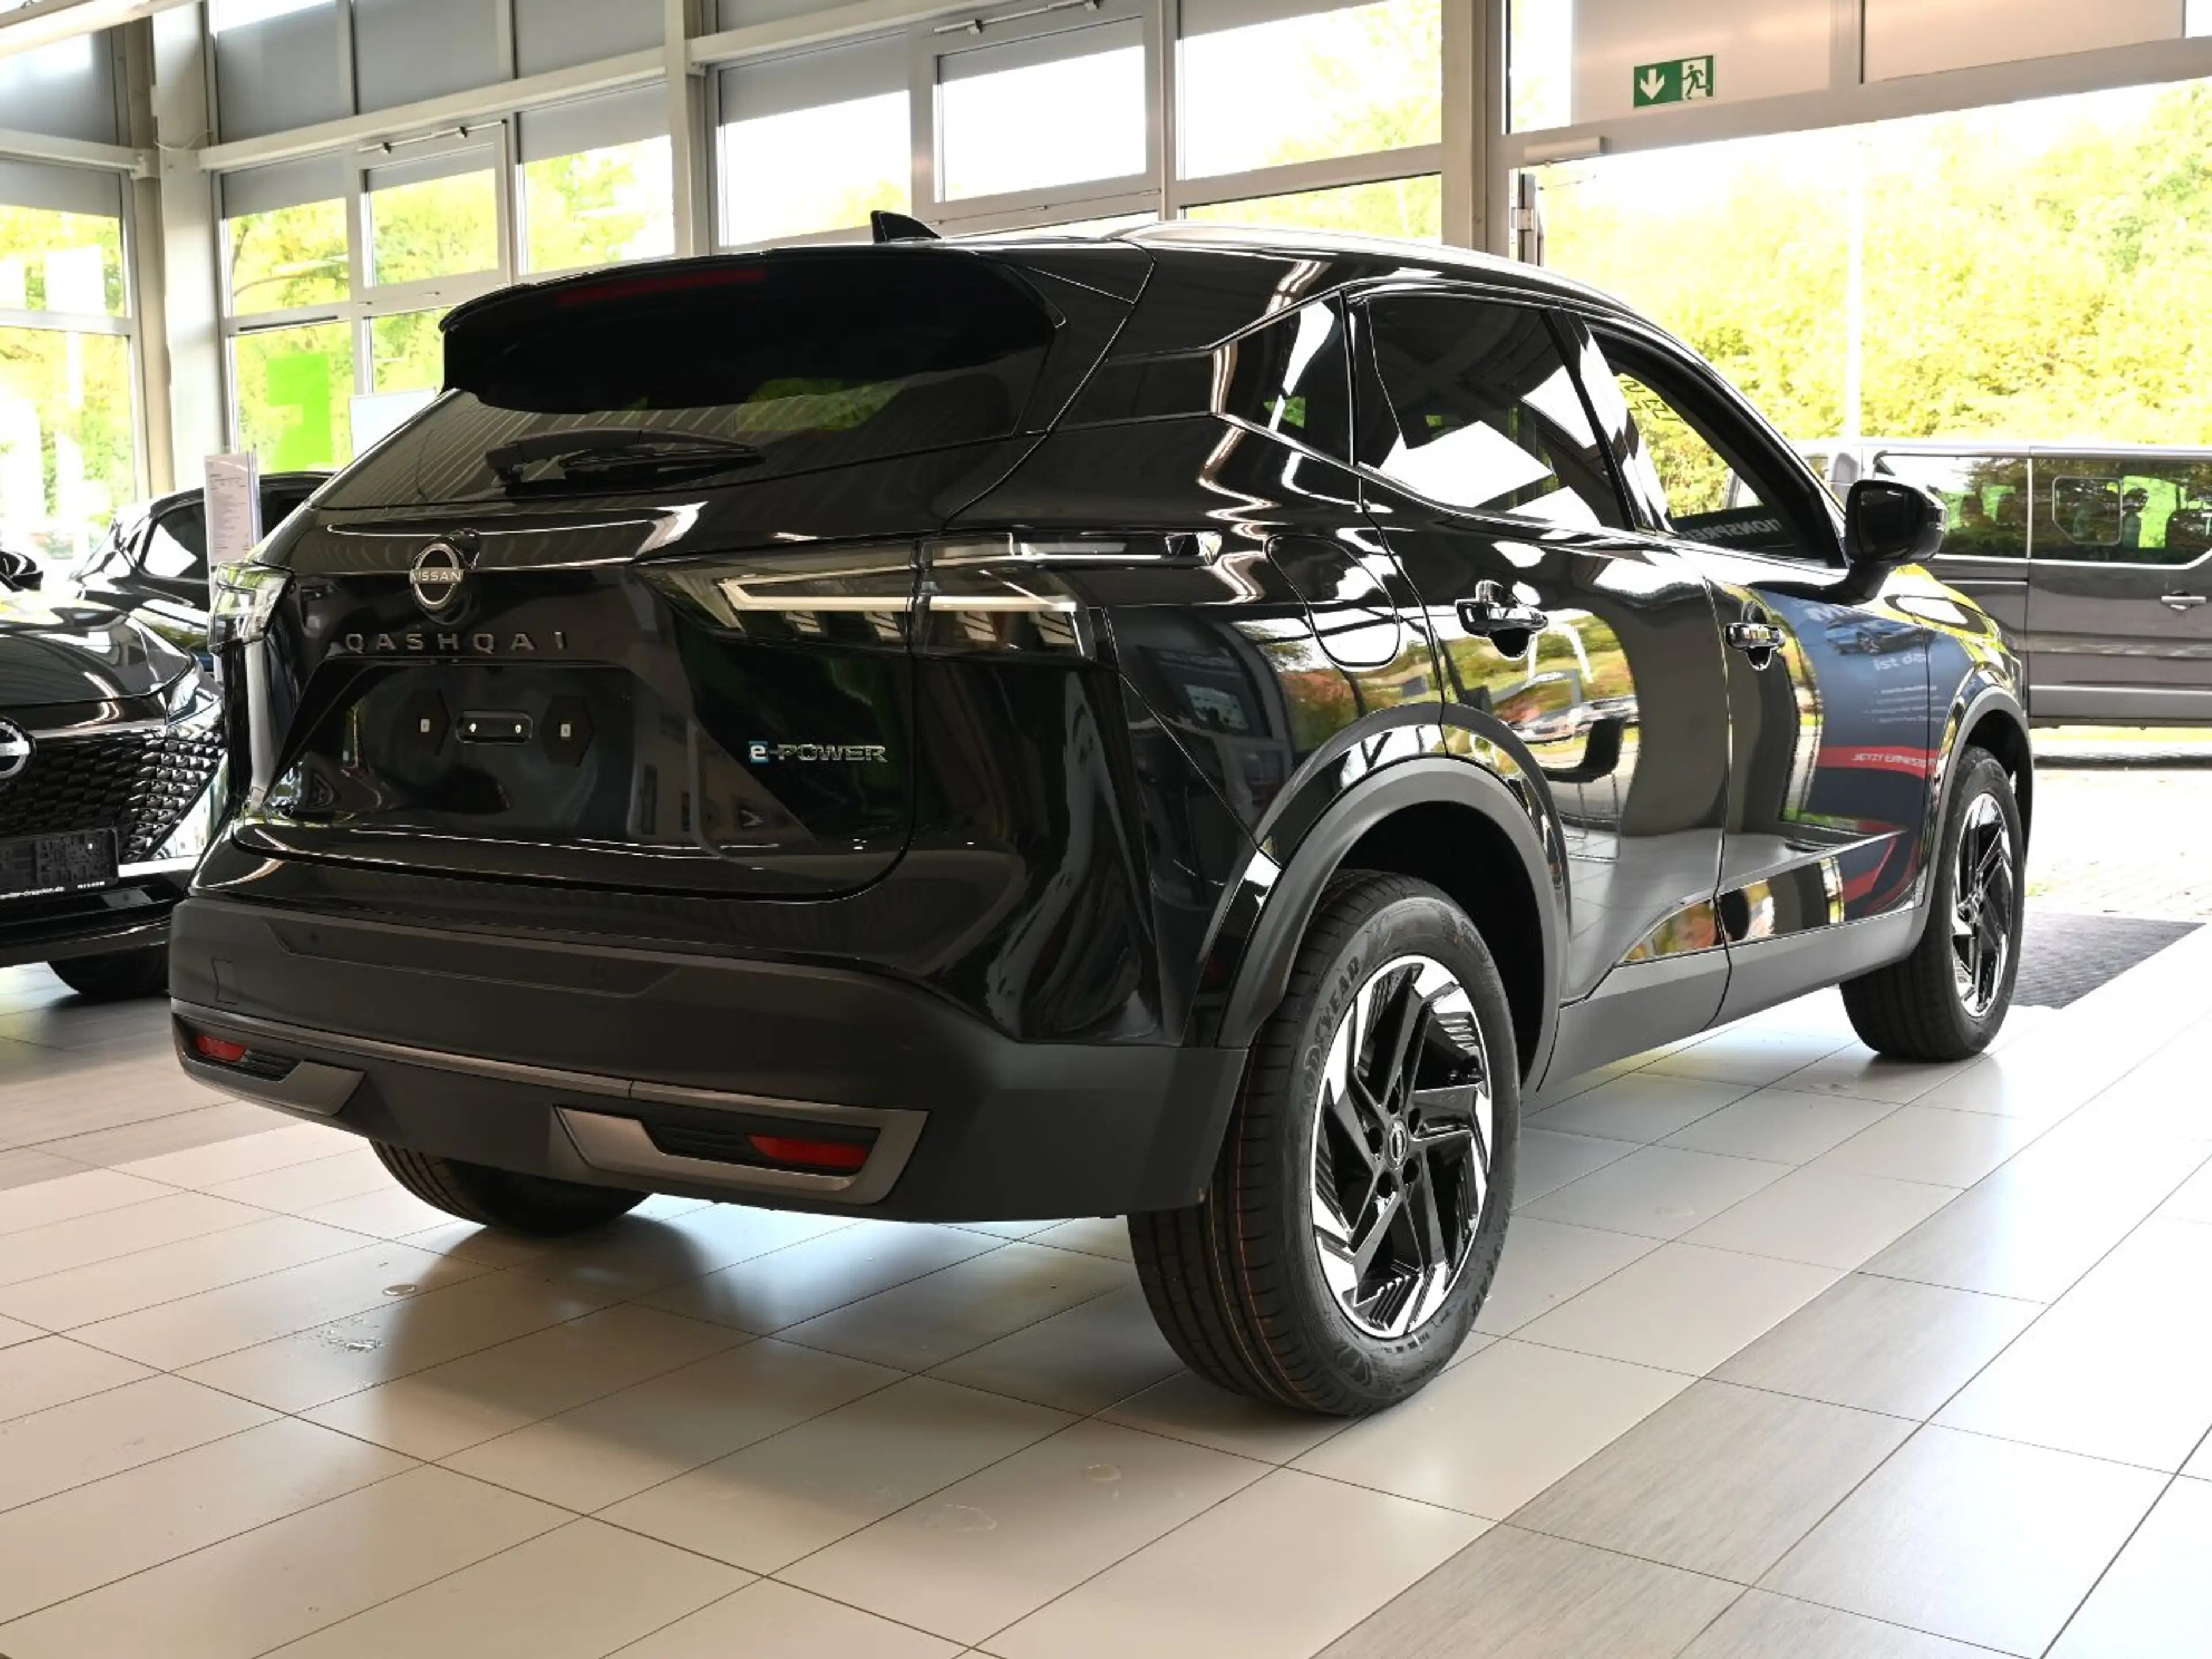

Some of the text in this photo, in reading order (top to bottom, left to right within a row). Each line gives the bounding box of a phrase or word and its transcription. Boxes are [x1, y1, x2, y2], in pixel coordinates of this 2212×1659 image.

[412, 570, 462, 582] NISSAN
[344, 630, 566, 654] QASHQAI
[749, 742, 888, 763] e-POWER
